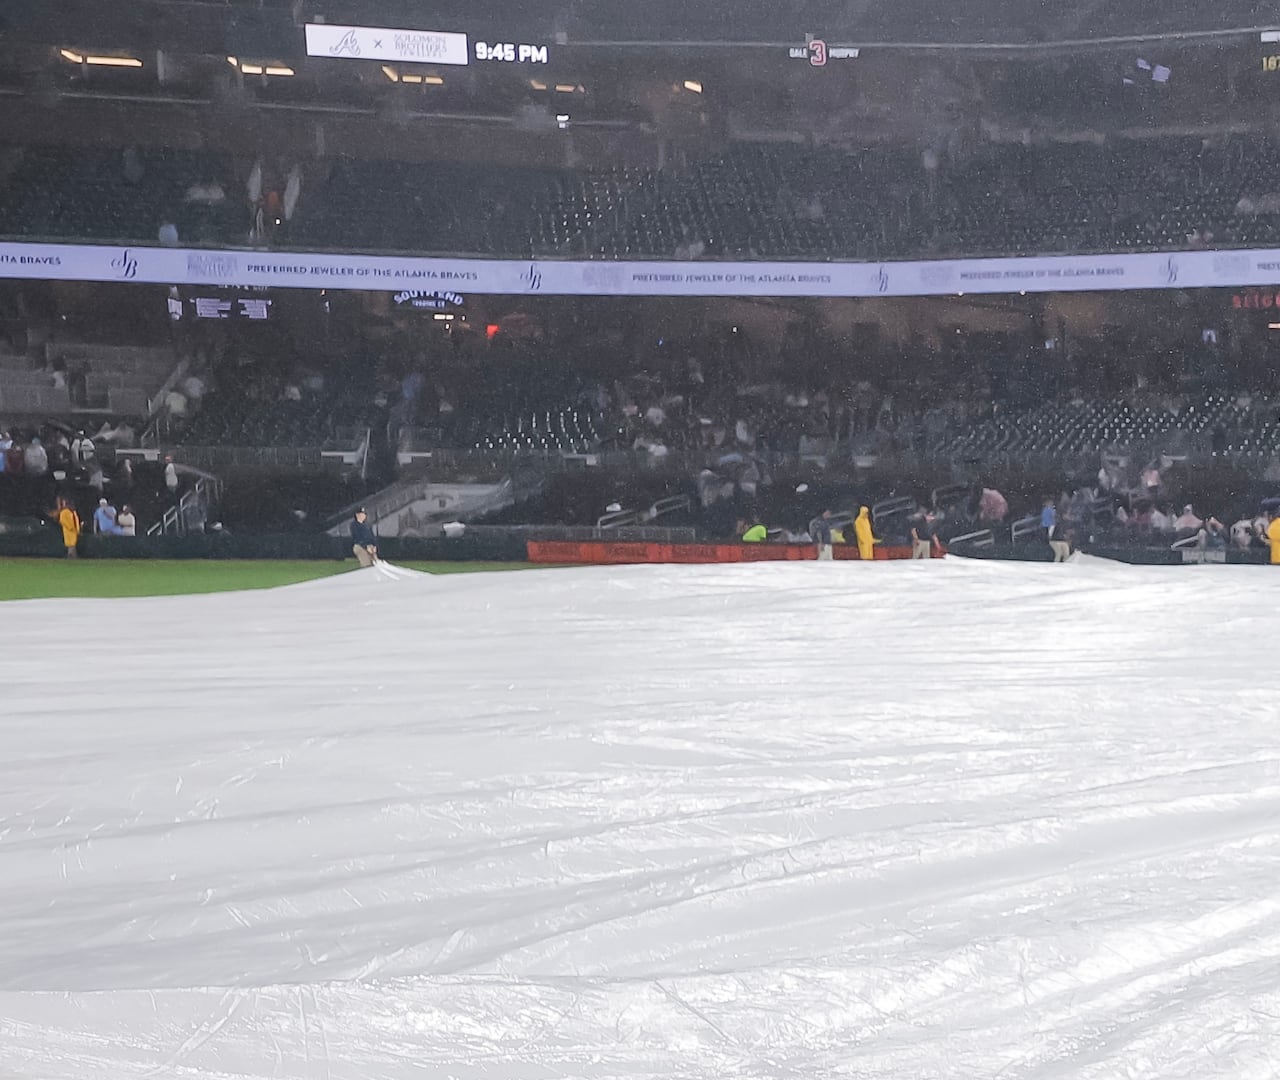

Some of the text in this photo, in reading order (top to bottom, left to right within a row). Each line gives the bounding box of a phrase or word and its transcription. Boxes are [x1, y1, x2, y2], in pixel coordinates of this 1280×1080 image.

[475, 41, 548, 64] 9:45 PM
[809, 40, 827, 66] 3
[20, 256, 61, 266] BRAVES
[247, 263, 307, 275] PREFERRED
[310, 265, 354, 276] JEWELER
[356, 267, 370, 277] OF
[374, 267, 392, 278] THE
[394, 268, 438, 279] ATLANTA
[440, 271, 478, 281] BRAVES
